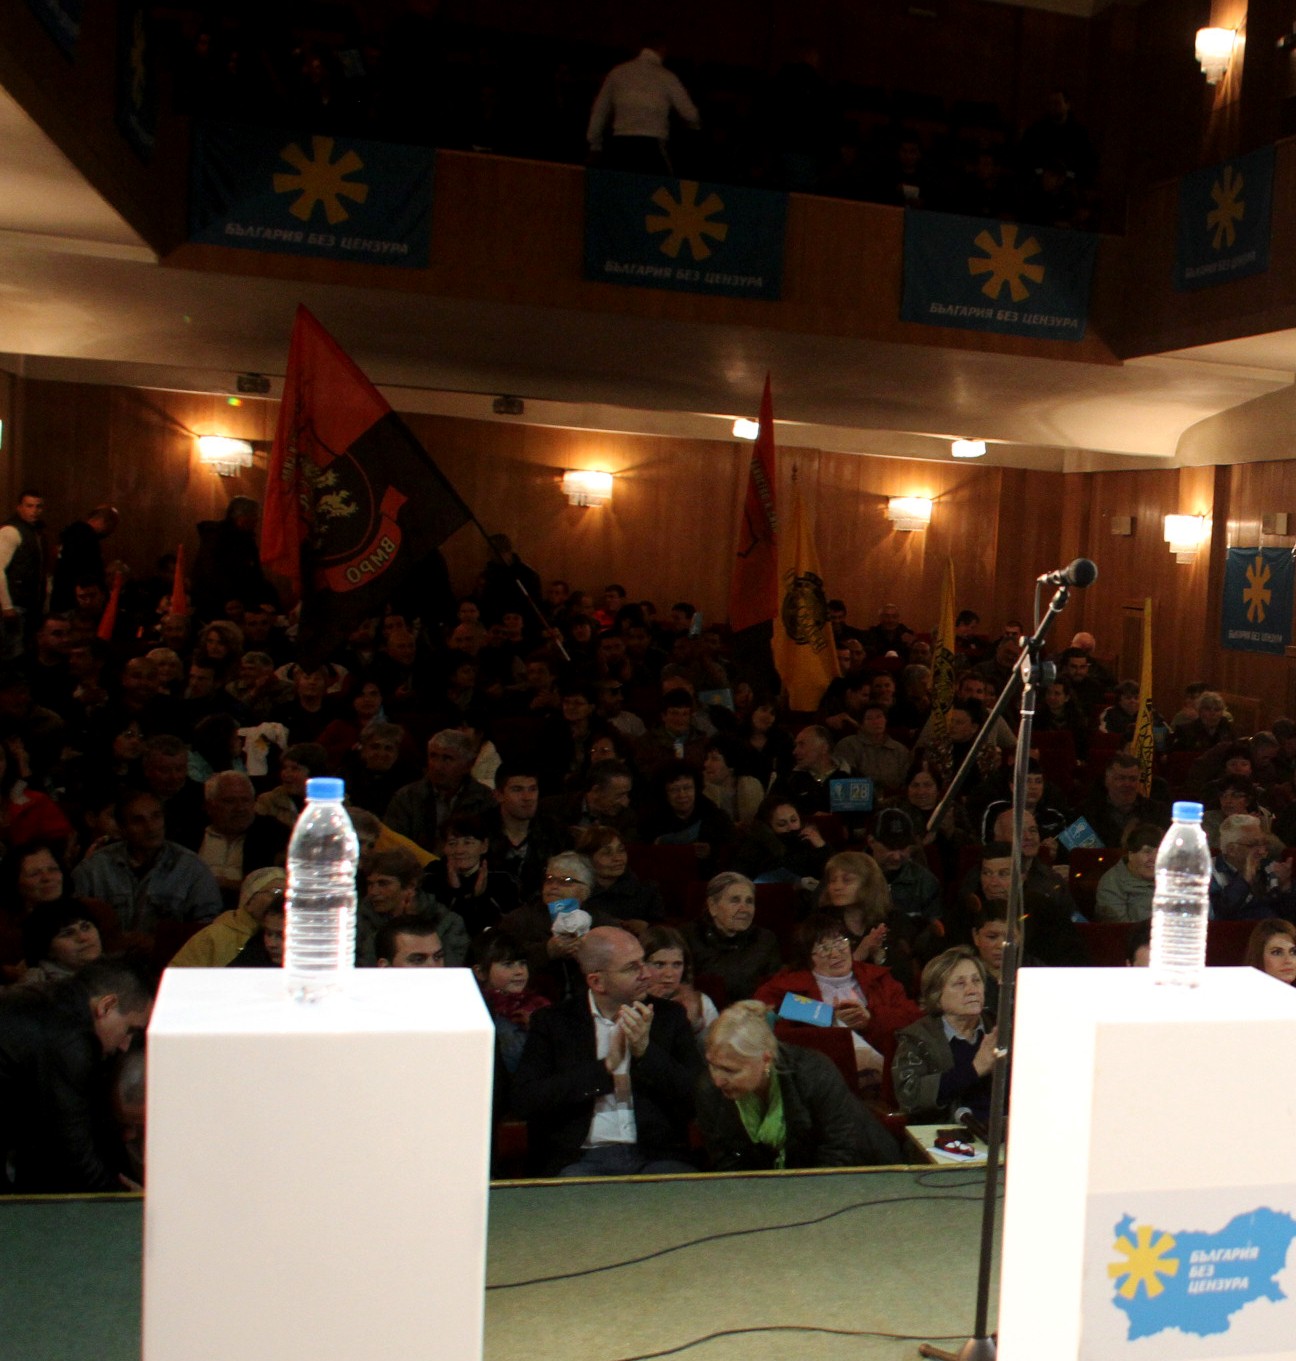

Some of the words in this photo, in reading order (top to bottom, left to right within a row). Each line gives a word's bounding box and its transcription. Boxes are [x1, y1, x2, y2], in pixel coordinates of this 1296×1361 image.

[307, 232, 337, 248] БЕЗ
[675, 268, 700, 281] БЕЗ
[929, 302, 993, 319] БЪЛГАРИЯ
[996, 309, 1018, 322] БЕЗ
[1022, 312, 1079, 328] ЦЕНЗУРА
[1188, 1264, 1215, 1280] БЕЗ
[1187, 1276, 1249, 1295] ЦЕНЗУРА
